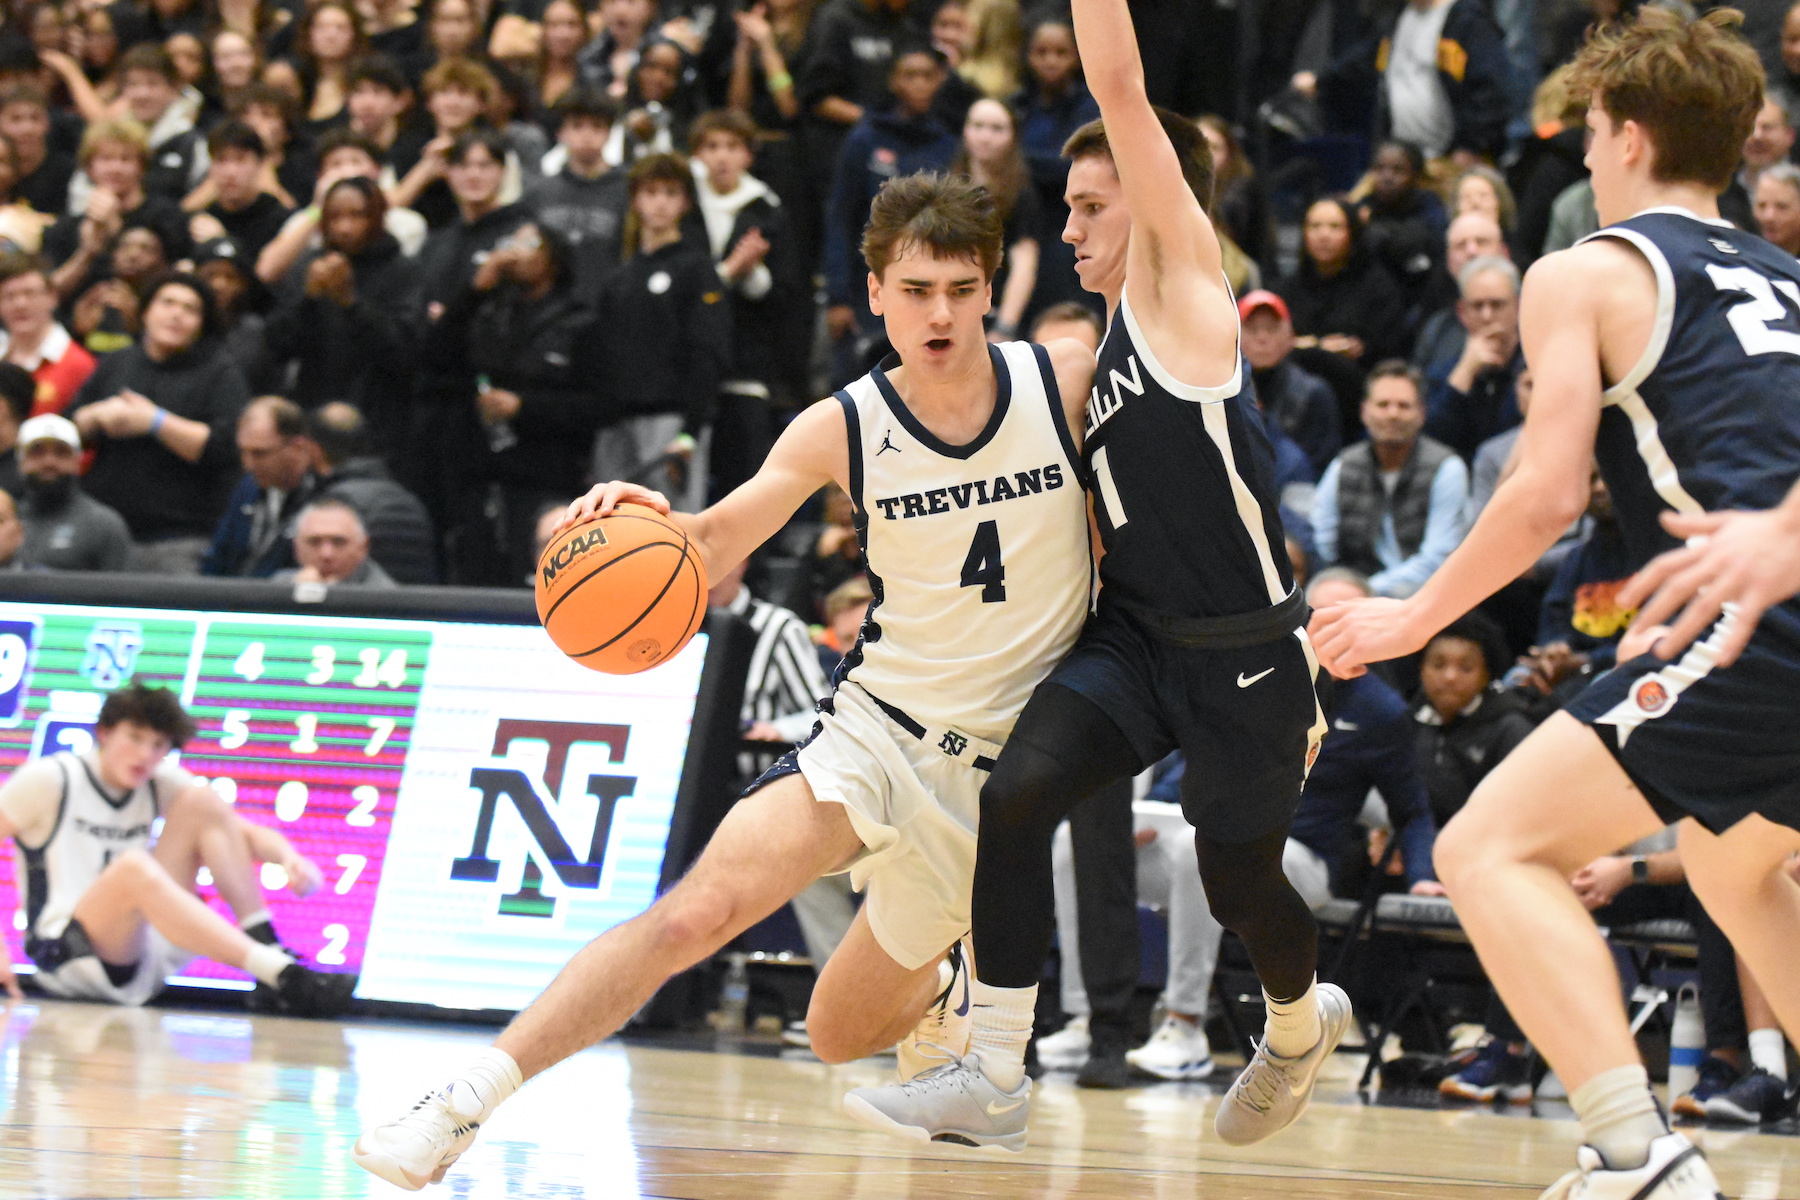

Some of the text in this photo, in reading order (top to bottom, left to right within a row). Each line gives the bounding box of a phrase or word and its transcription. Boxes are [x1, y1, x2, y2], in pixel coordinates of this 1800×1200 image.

[1704, 263, 1800, 356] 2
[876, 463, 1064, 520] TREVIANS
[1091, 445, 1128, 530] 1
[543, 526, 609, 589] NCAA
[960, 519, 1006, 603] 4
[233, 642, 408, 688] 4 3 14
[220, 710, 396, 757] 5 1 7
[346, 785, 379, 827] 2
[335, 854, 367, 894] 7
[316, 923, 349, 965] 2
